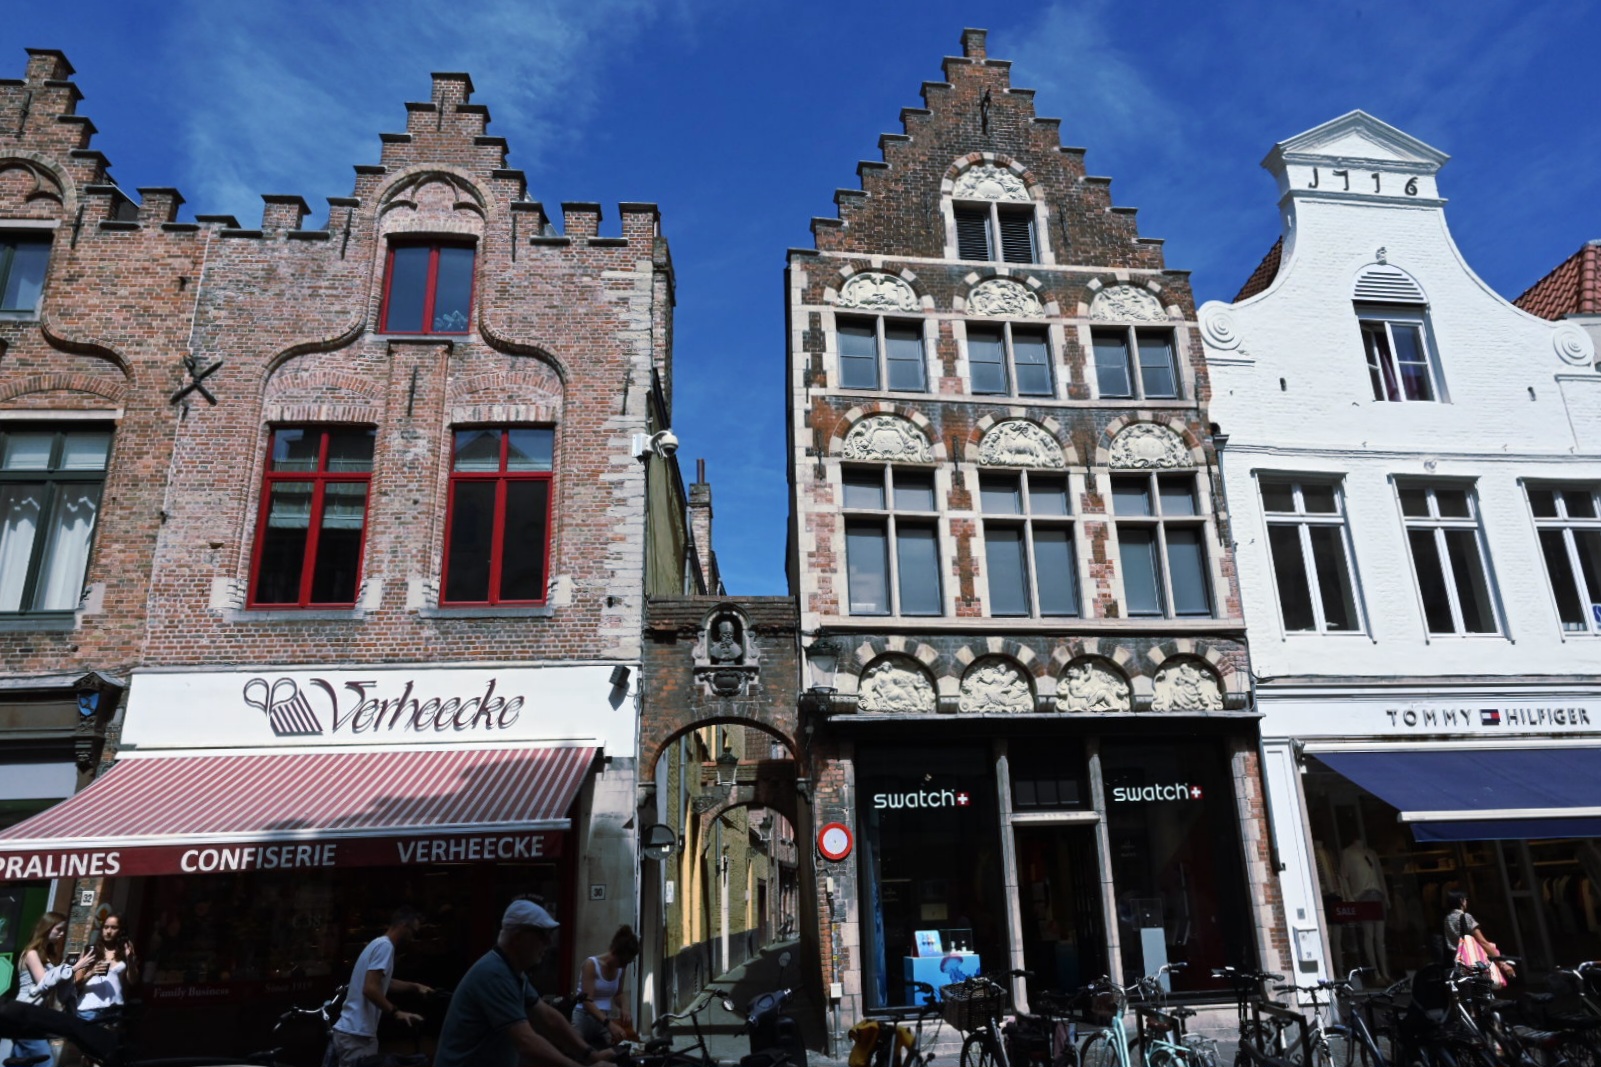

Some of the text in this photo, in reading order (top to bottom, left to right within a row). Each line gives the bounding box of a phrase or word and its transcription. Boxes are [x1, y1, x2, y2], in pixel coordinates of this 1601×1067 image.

[310, 678, 525, 734] Verheecke
[1386, 707, 1591, 727] TOMMY HILFIGER
[873, 789, 955, 809] swatch
[1112, 783, 1189, 802] swatch
[181, 844, 337, 873] CONFISERIE
[397, 835, 544, 864] VERHEECKE
[82, 893, 92, 904] 32
[594, 887, 603, 897] 30
[1336, 906, 1357, 916] SALE
[153, 987, 187, 999] Family
[188, 986, 229, 997] Business
